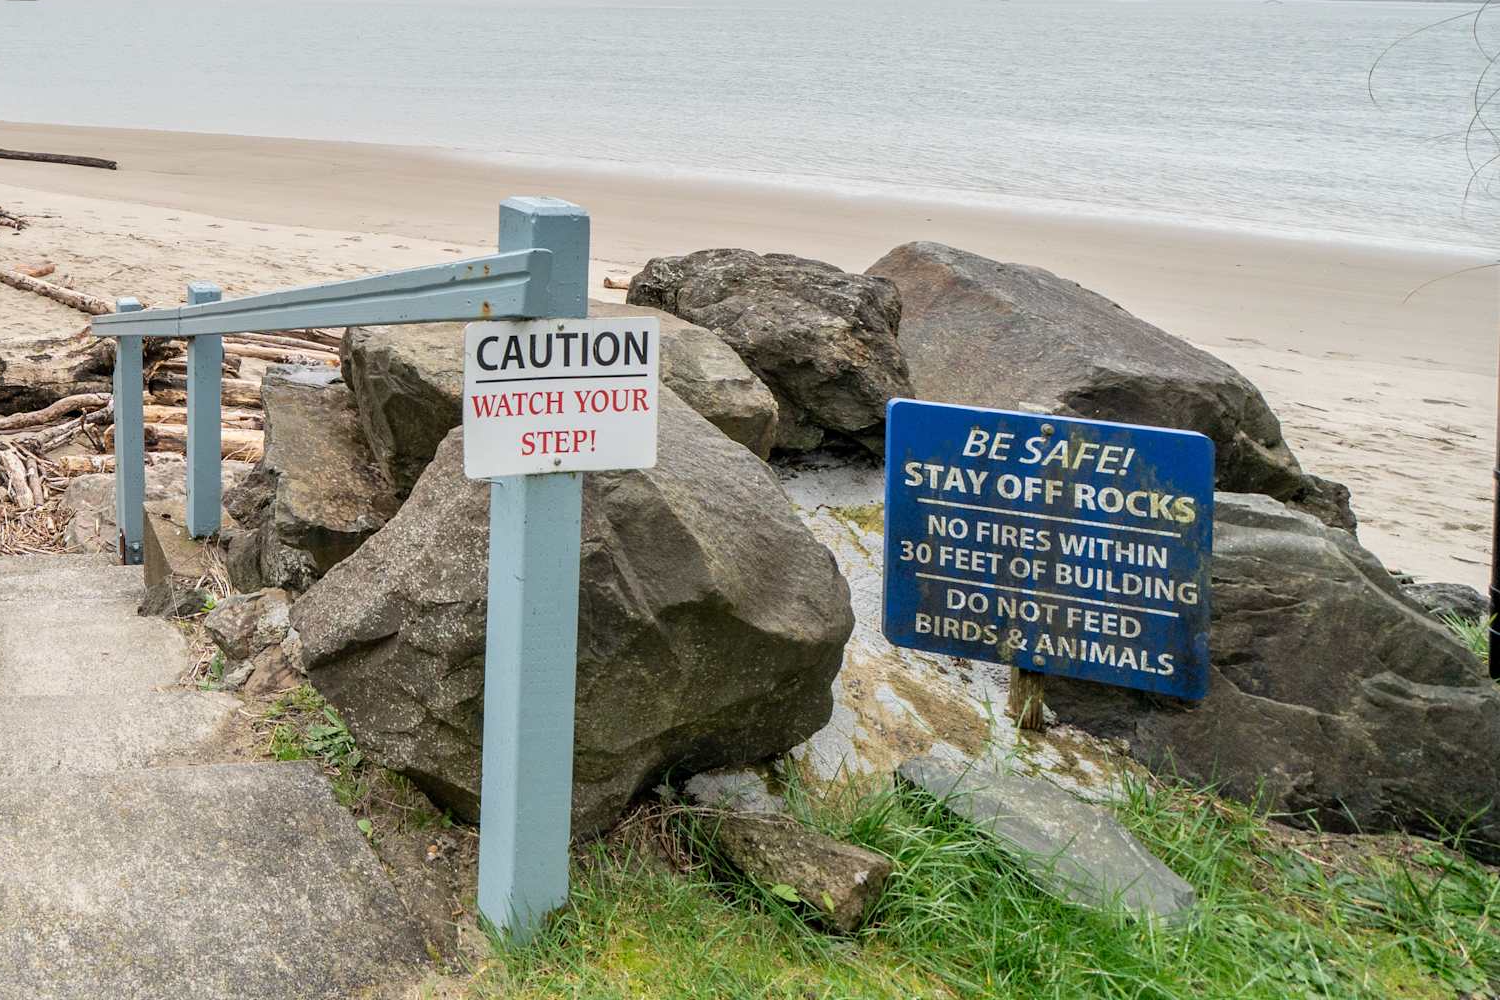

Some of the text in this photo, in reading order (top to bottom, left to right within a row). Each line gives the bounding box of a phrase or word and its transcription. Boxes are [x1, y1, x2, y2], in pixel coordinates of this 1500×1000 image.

[476, 331, 649, 371] CAUTION
[472, 388, 650, 418] WATCH YOUR
[521, 430, 597, 456] STEP!
[962, 429, 1136, 476] BE SAFE!
[904, 462, 1197, 524] STAY OFF ROCKS
[927, 514, 1168, 569] NO FIRES WITHIN
[899, 540, 1198, 605] 30 FEET OF BUILDING
[946, 588, 1142, 639] DO NOT FEED
[915, 613, 1175, 677] BIRDS & ANIMALS
